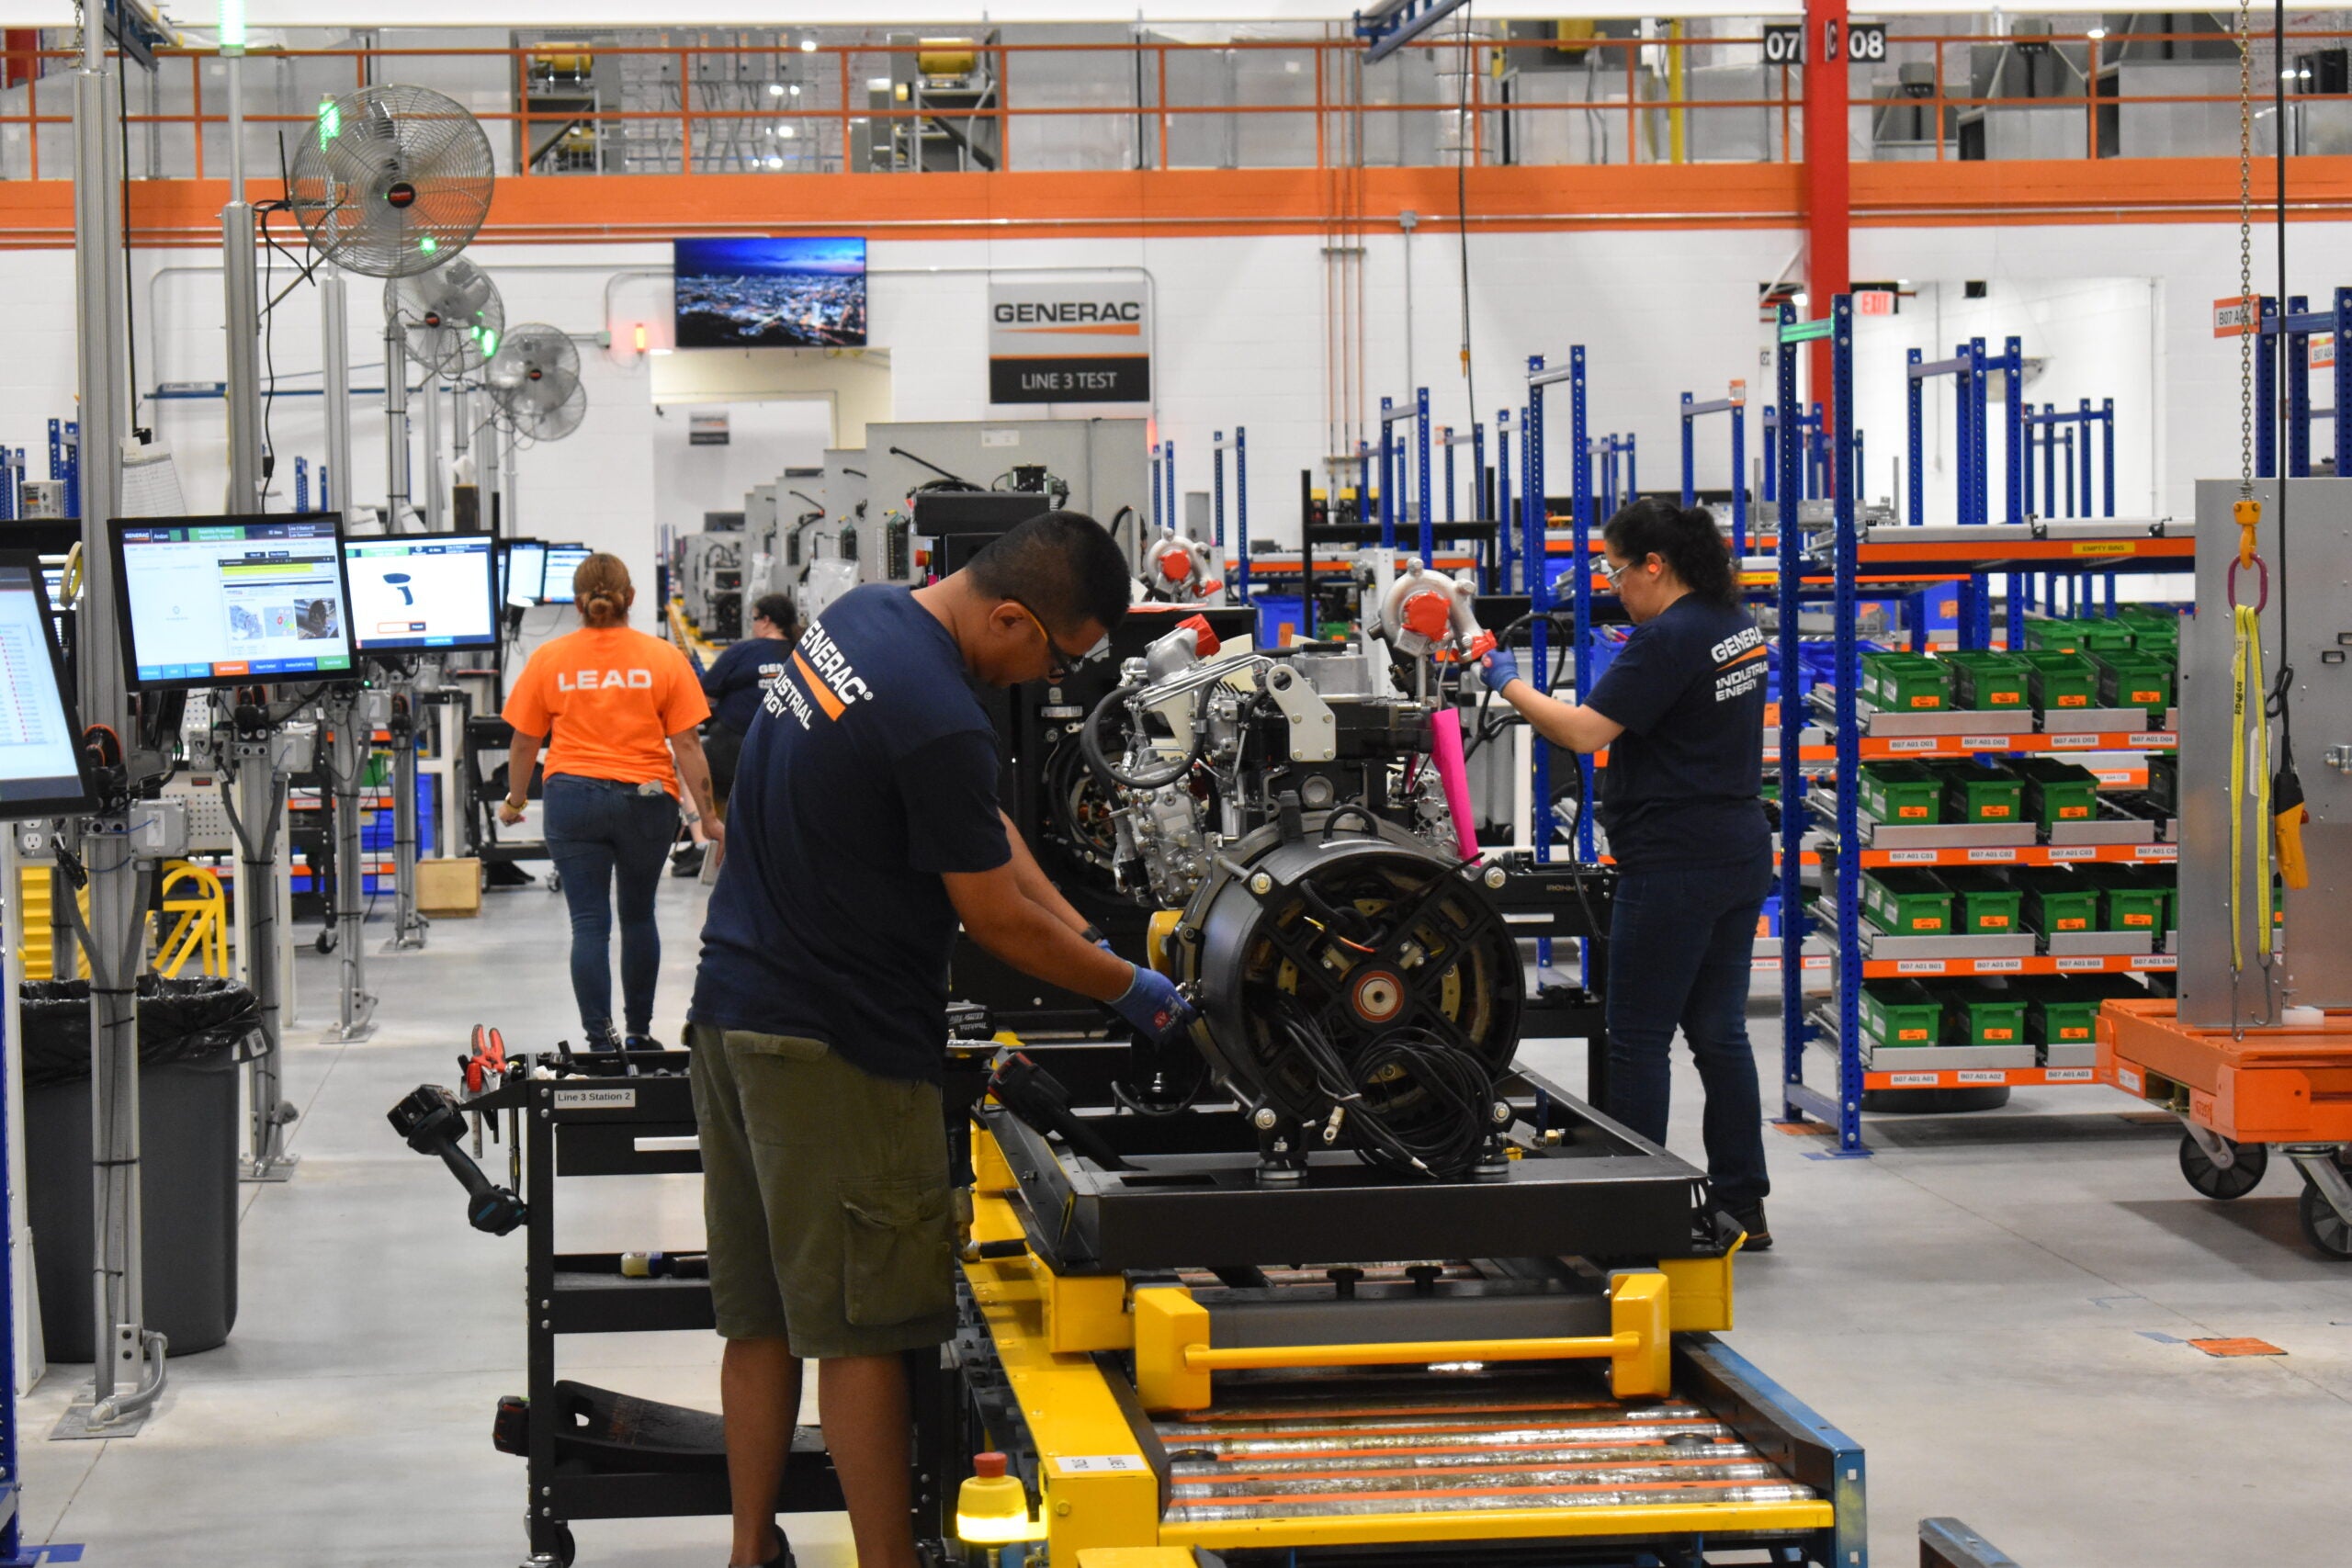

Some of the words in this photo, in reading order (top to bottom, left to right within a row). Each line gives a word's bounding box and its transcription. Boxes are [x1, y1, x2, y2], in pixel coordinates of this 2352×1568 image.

[1766, 31, 1800, 61] 07
[1849, 30, 1884, 59] 08
[994, 302, 1140, 322] GENERAC
[1861, 292, 1890, 315] EXIT
[2219, 310, 2233, 325] B07
[1022, 373, 1058, 389] LINE
[1064, 373, 1074, 389] 3
[1077, 372, 1117, 389] TEST
[558, 669, 652, 693] LEAD
[1714, 678, 1757, 702] ENERGY
[559, 1093, 579, 1101] Line
[581, 1093, 586, 1101] 3
[589, 1092, 622, 1100] Station
[625, 1092, 630, 1100] 2
